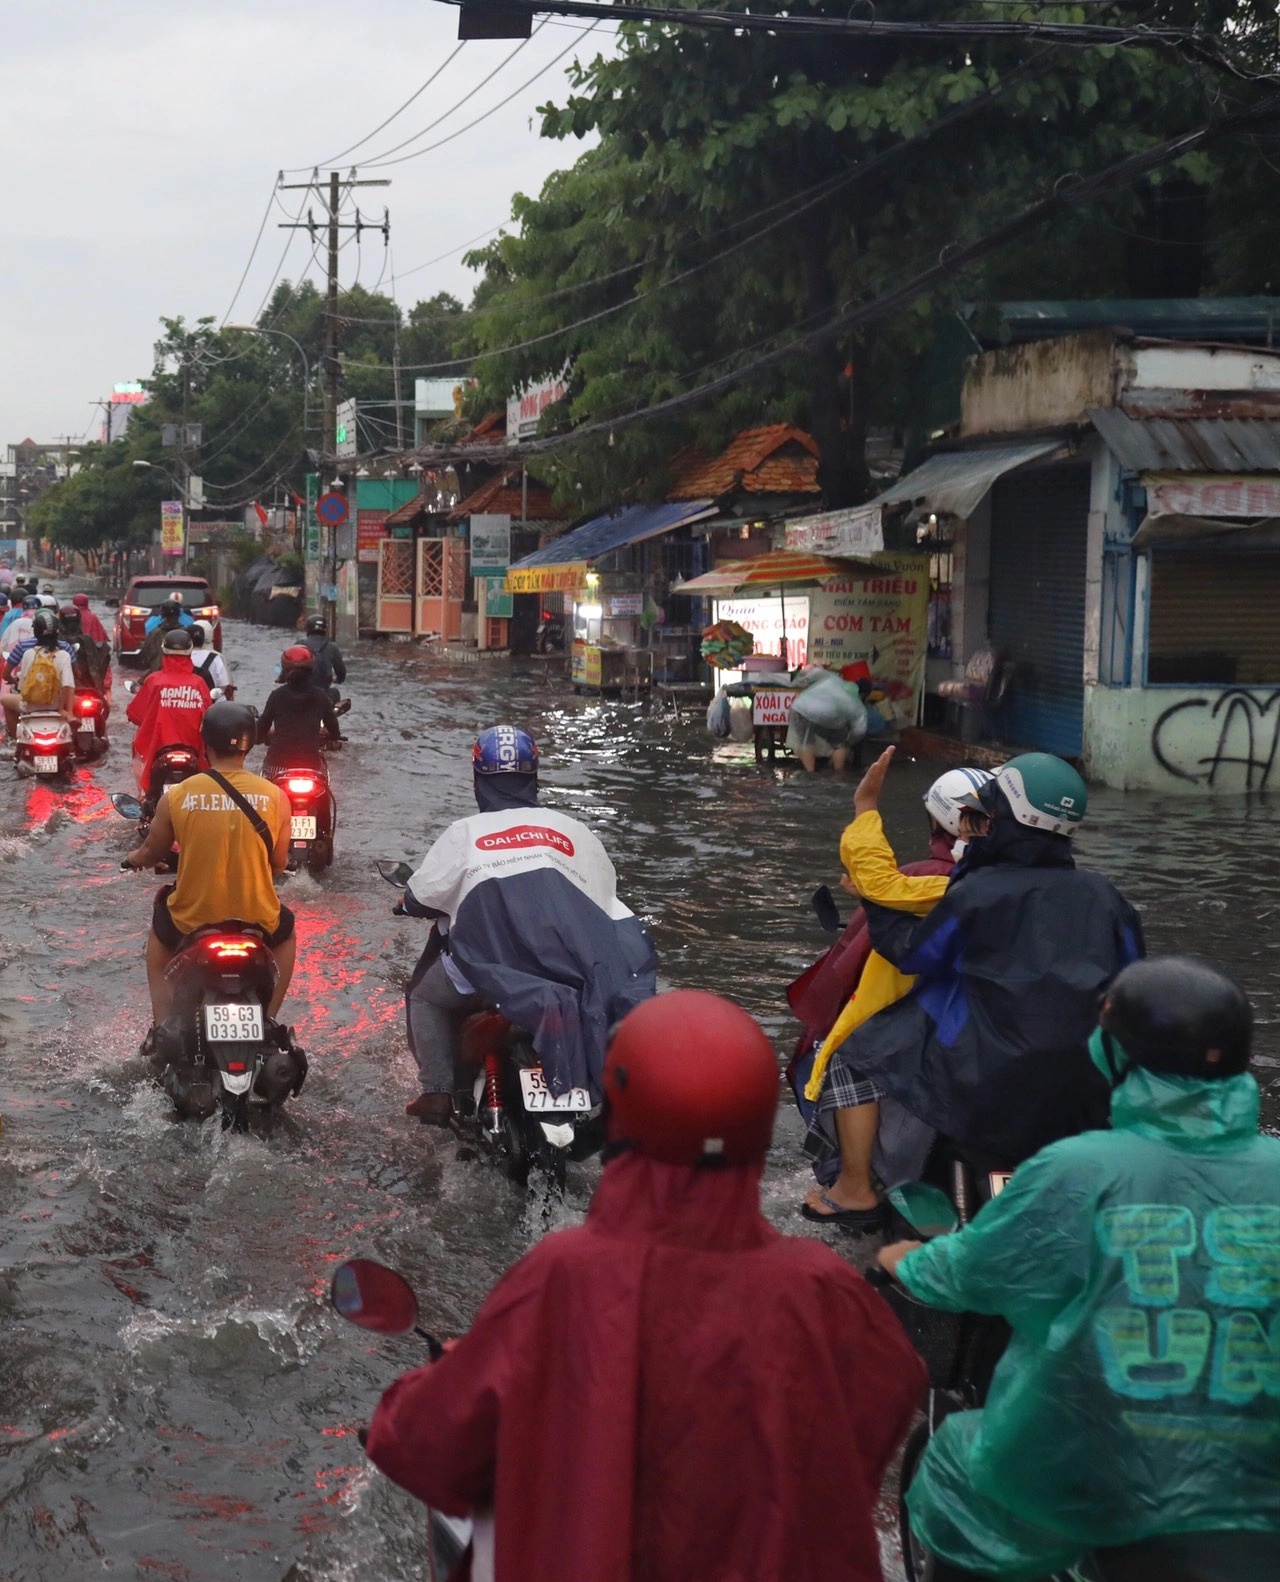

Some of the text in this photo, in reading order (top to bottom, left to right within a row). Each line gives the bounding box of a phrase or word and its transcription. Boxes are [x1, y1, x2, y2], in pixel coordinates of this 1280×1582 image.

[824, 610, 912, 632] CƠM TẤM
[756, 692, 781, 710] XOÀI
[483, 832, 570, 851] DAI-ICHI LIFE
[213, 1006, 254, 1022] 59-G3
[210, 1023, 260, 1039] 033.50
[530, 1072, 548, 1089] 59
